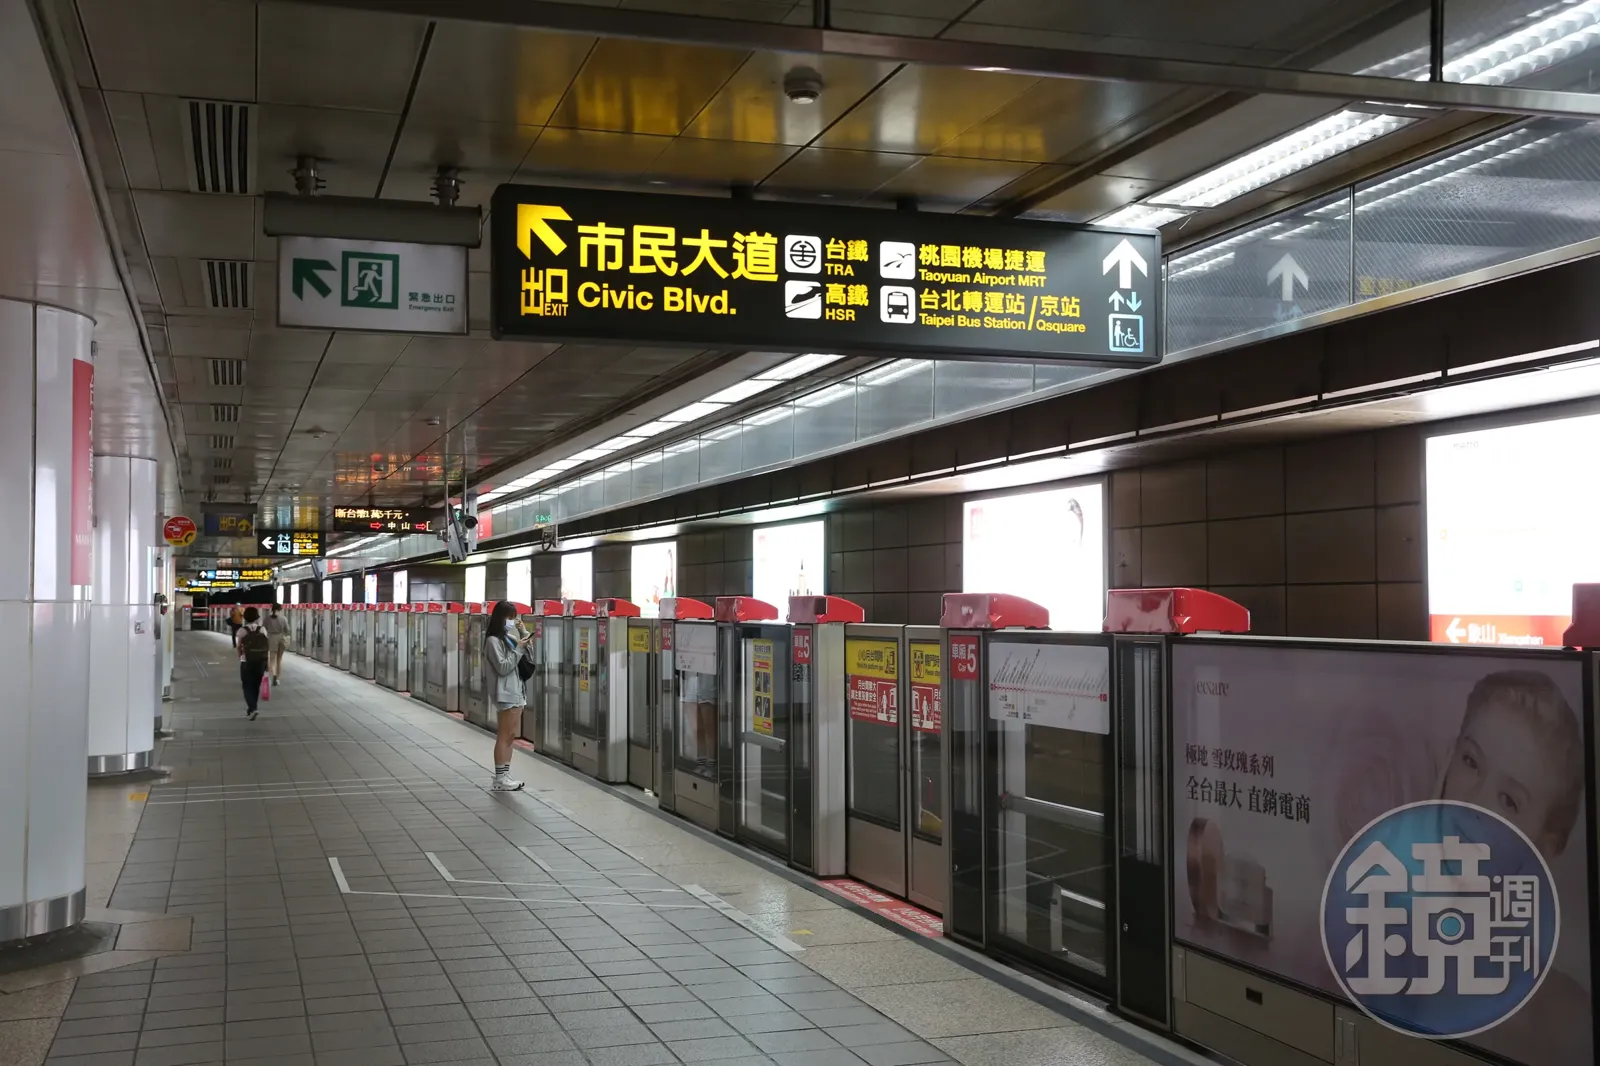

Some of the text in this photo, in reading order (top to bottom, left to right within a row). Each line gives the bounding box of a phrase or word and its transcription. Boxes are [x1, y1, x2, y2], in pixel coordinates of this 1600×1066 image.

[578, 222, 778, 282] 市民大道
[826, 238, 868, 262] 台鐵
[919, 244, 1046, 273] 桃園機場捷運
[825, 263, 854, 277] TRA
[919, 269, 1047, 287] Taoyuan Airport MRT
[408, 292, 455, 304] 緊急出口
[521, 267, 568, 316] 出口
[577, 281, 737, 315] Civic Blvd.
[826, 283, 869, 307] 高鐵
[544, 302, 569, 316] EXIT
[825, 308, 856, 321] HSR
[919, 313, 1086, 333] Taipei Bus Station Qsquare
[219, 516, 236, 531] 出口
[803, 635, 810, 659] 5
[952, 643, 966, 659] 車廂
[967, 644, 977, 673] 5
[1186, 743, 1274, 779] 極地 雪玫瑰系列
[1186, 775, 1311, 824] 全台最大 直銷電商
